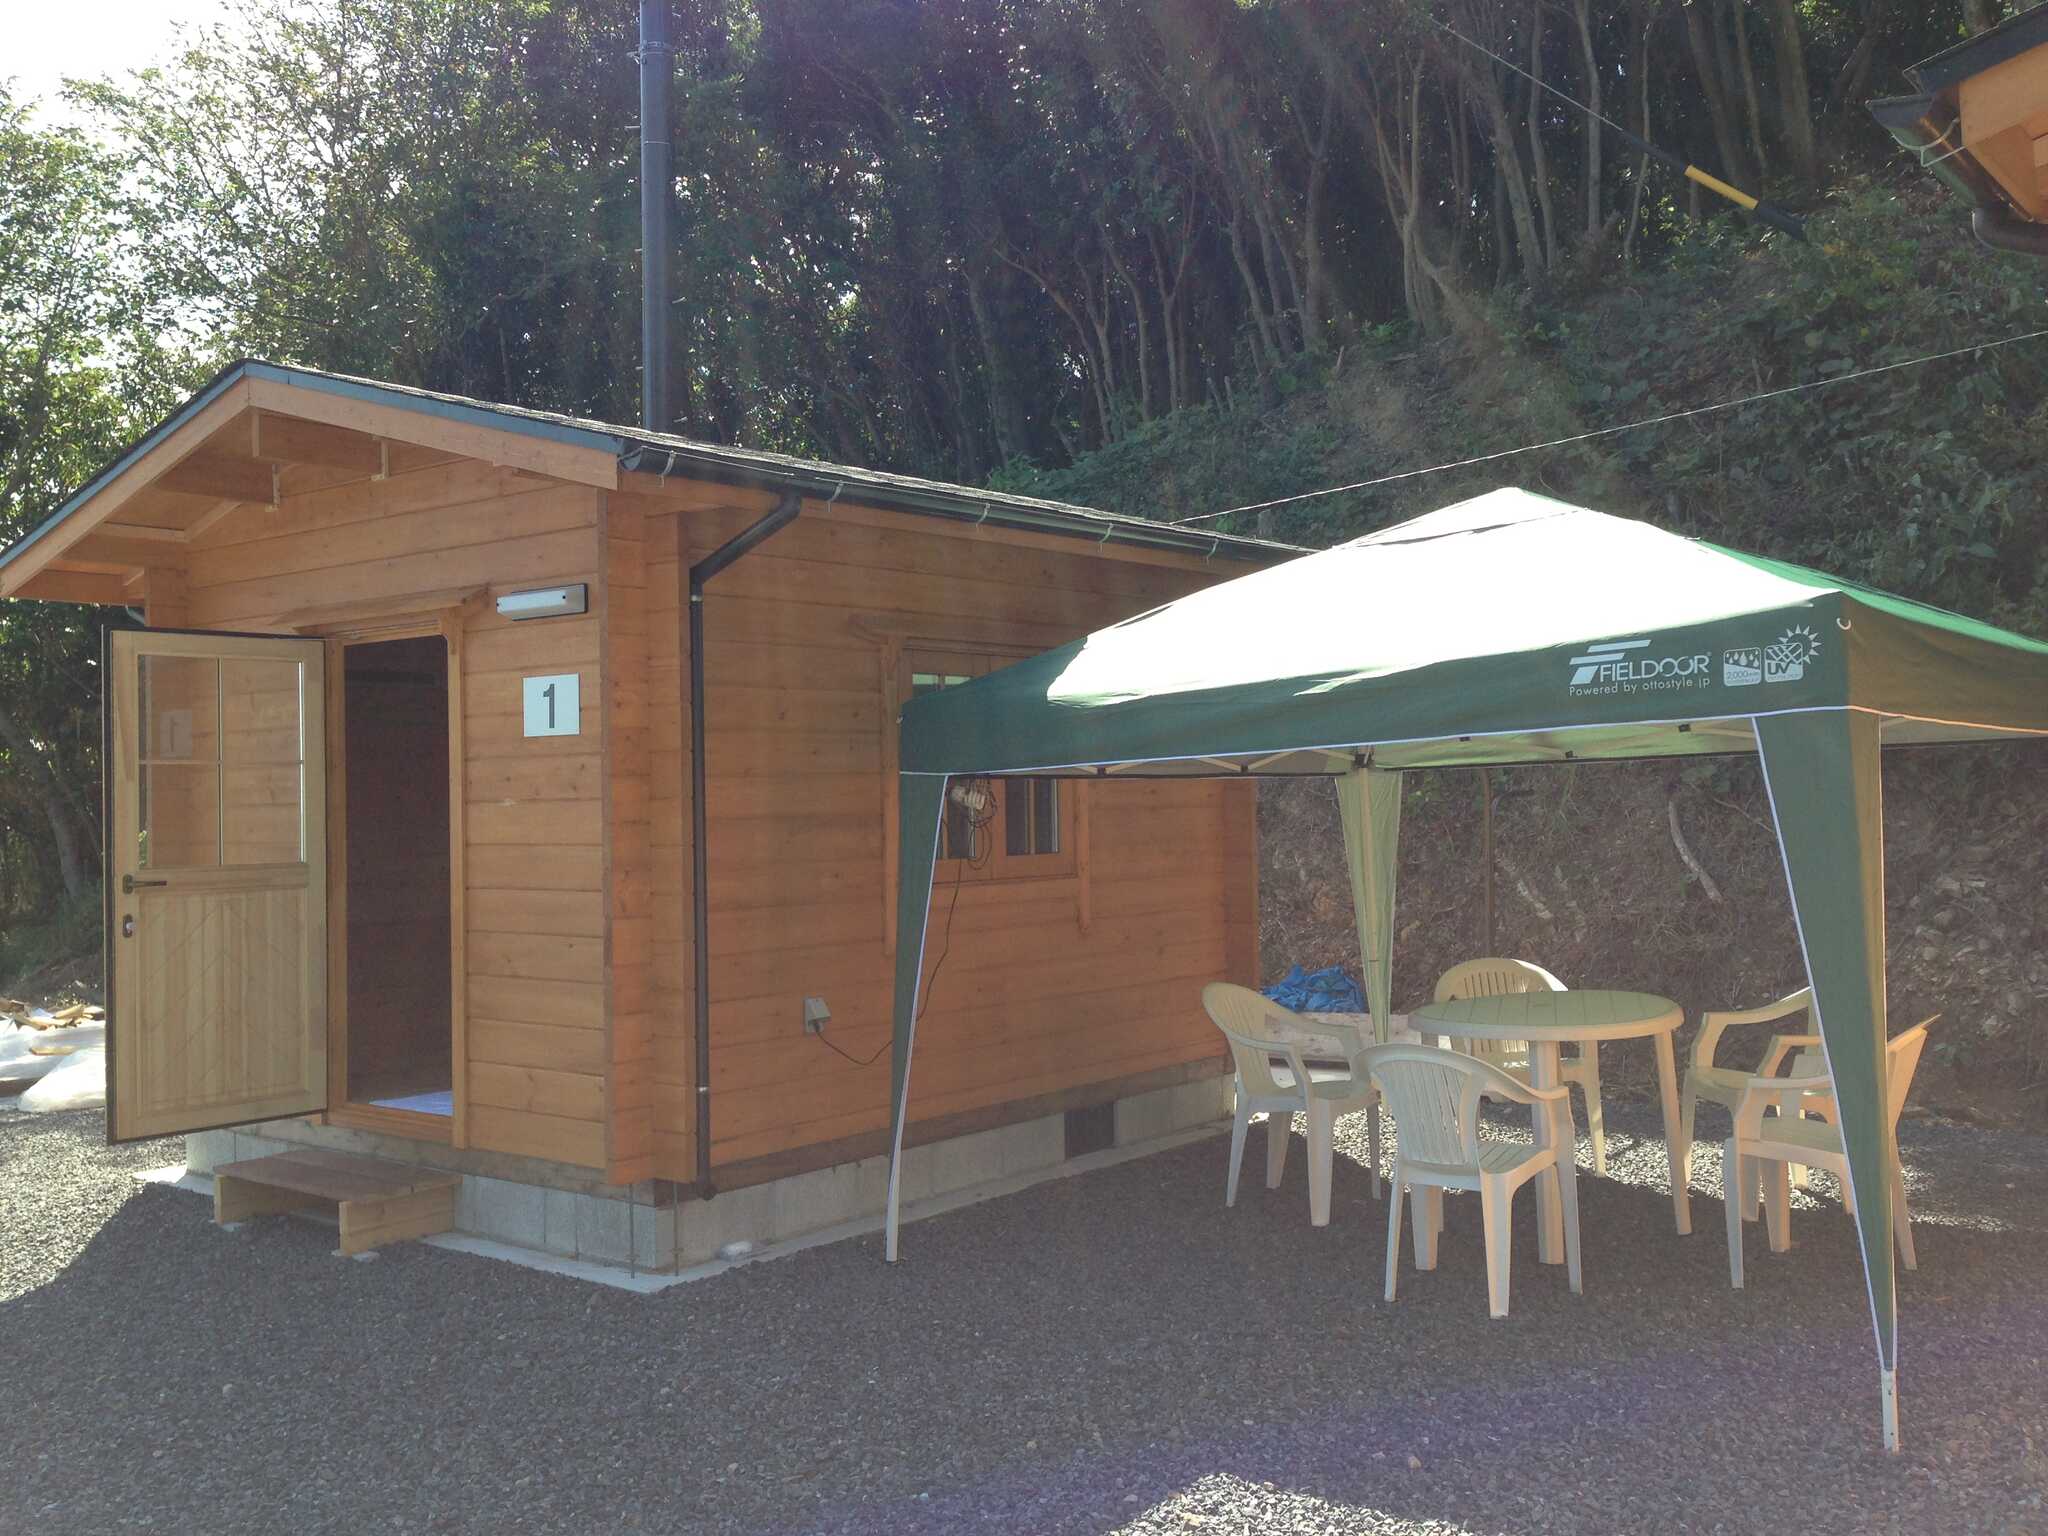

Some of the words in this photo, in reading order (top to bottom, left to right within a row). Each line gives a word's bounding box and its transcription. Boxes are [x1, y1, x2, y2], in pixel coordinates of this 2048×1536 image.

[1600, 655, 1710, 682] FIELDOOR
[1767, 661, 1791, 675] UV
[1569, 682, 1618, 697] Powered
[1623, 681, 1637, 693] by
[543, 683, 555, 729] 1
